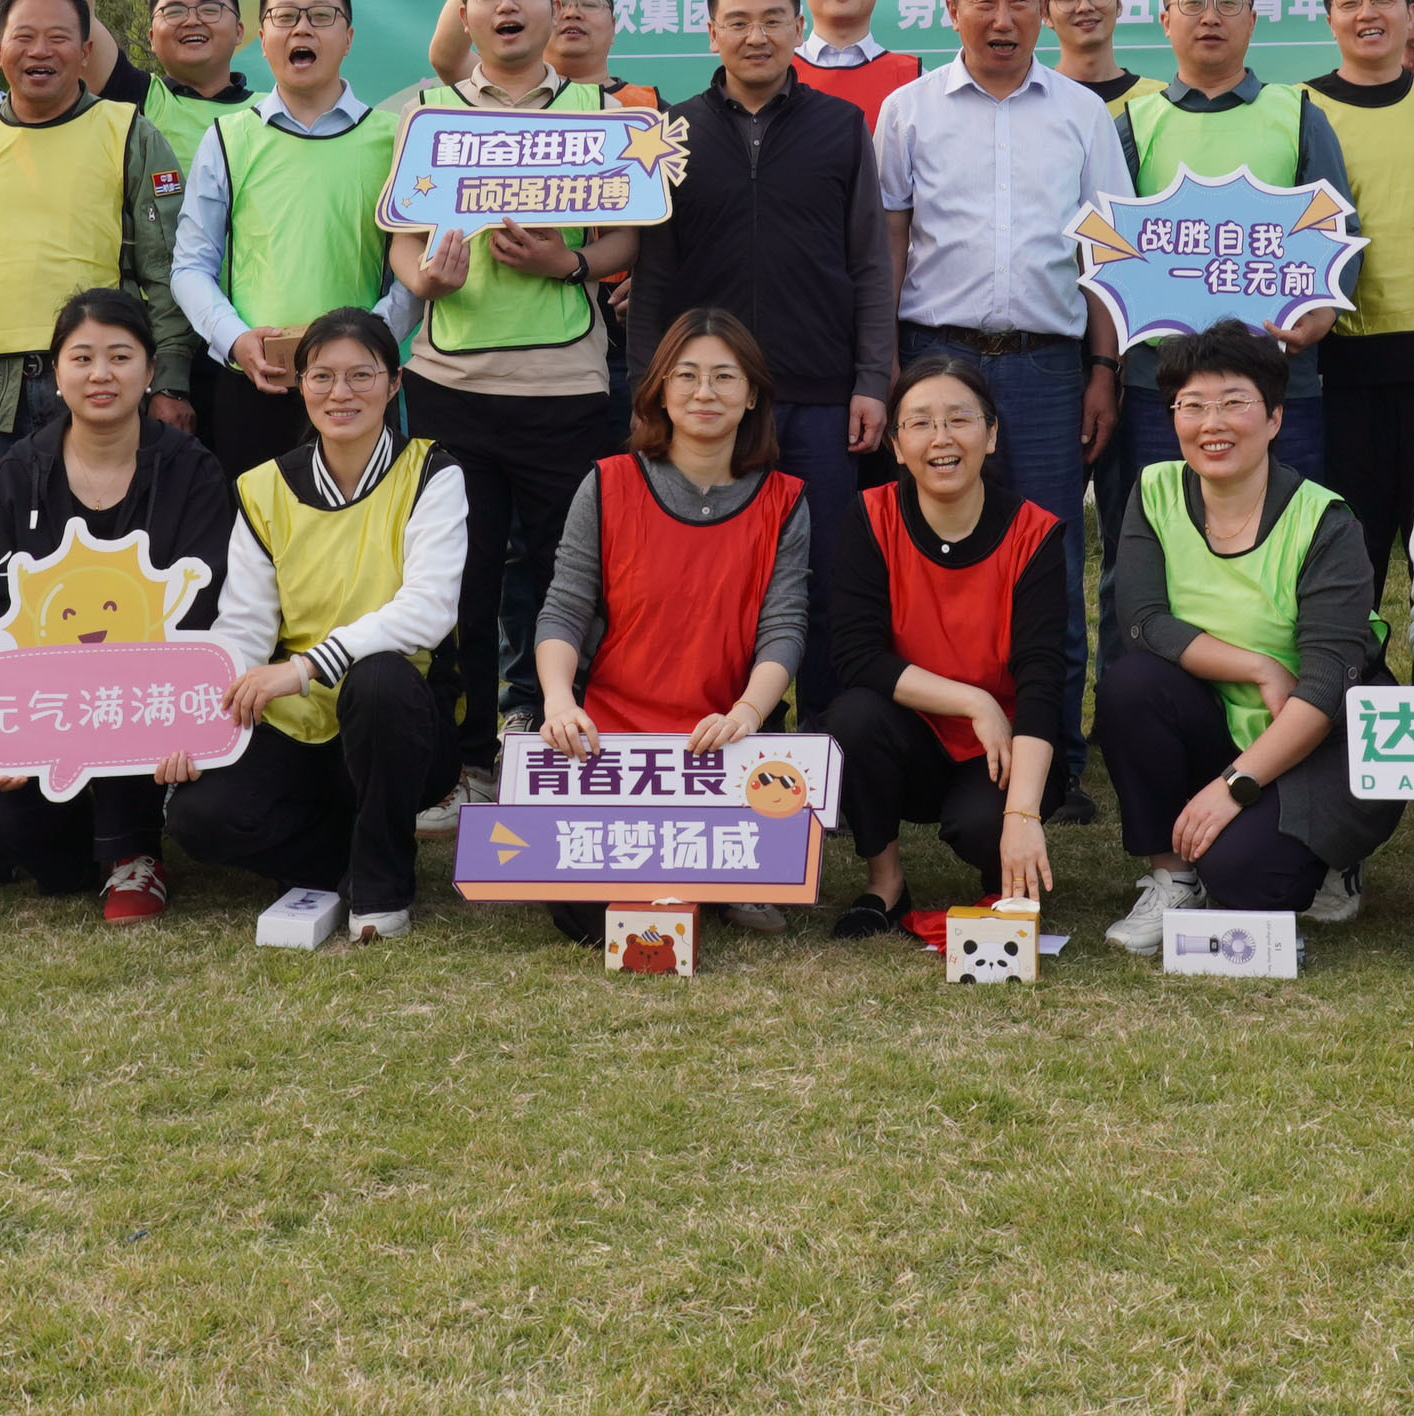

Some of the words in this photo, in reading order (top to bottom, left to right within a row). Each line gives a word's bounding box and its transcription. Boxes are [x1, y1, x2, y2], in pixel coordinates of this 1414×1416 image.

[435, 131, 605, 167] 勤奋进取
[459, 176, 630, 213] 顽强拼搏
[1140, 218, 1285, 257] 战胜自我
[1171, 260, 1315, 296] 一往无前
[526, 748, 727, 796] 青春无畏
[555, 820, 760, 870] 逐梦扬威
